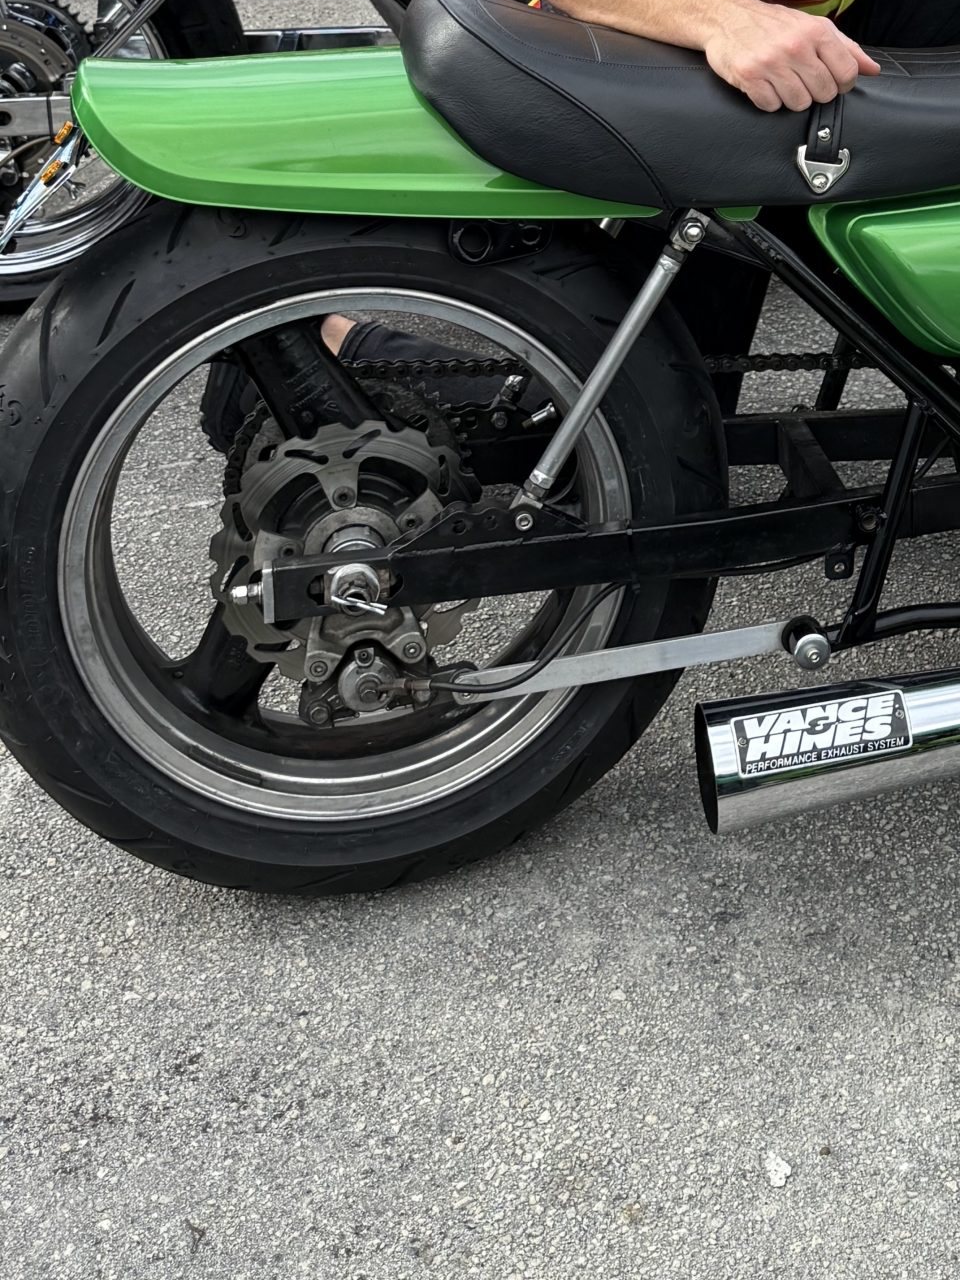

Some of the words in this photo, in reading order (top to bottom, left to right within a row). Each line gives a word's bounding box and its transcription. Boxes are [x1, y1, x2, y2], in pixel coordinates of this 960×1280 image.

[743, 693, 895, 739] VANCE
[746, 716, 893, 762] HINES
[745, 751, 818, 775] PERFORMANCE
[821, 743, 865, 760] EXHAUST
[867, 735, 905, 752] SYSTEM
